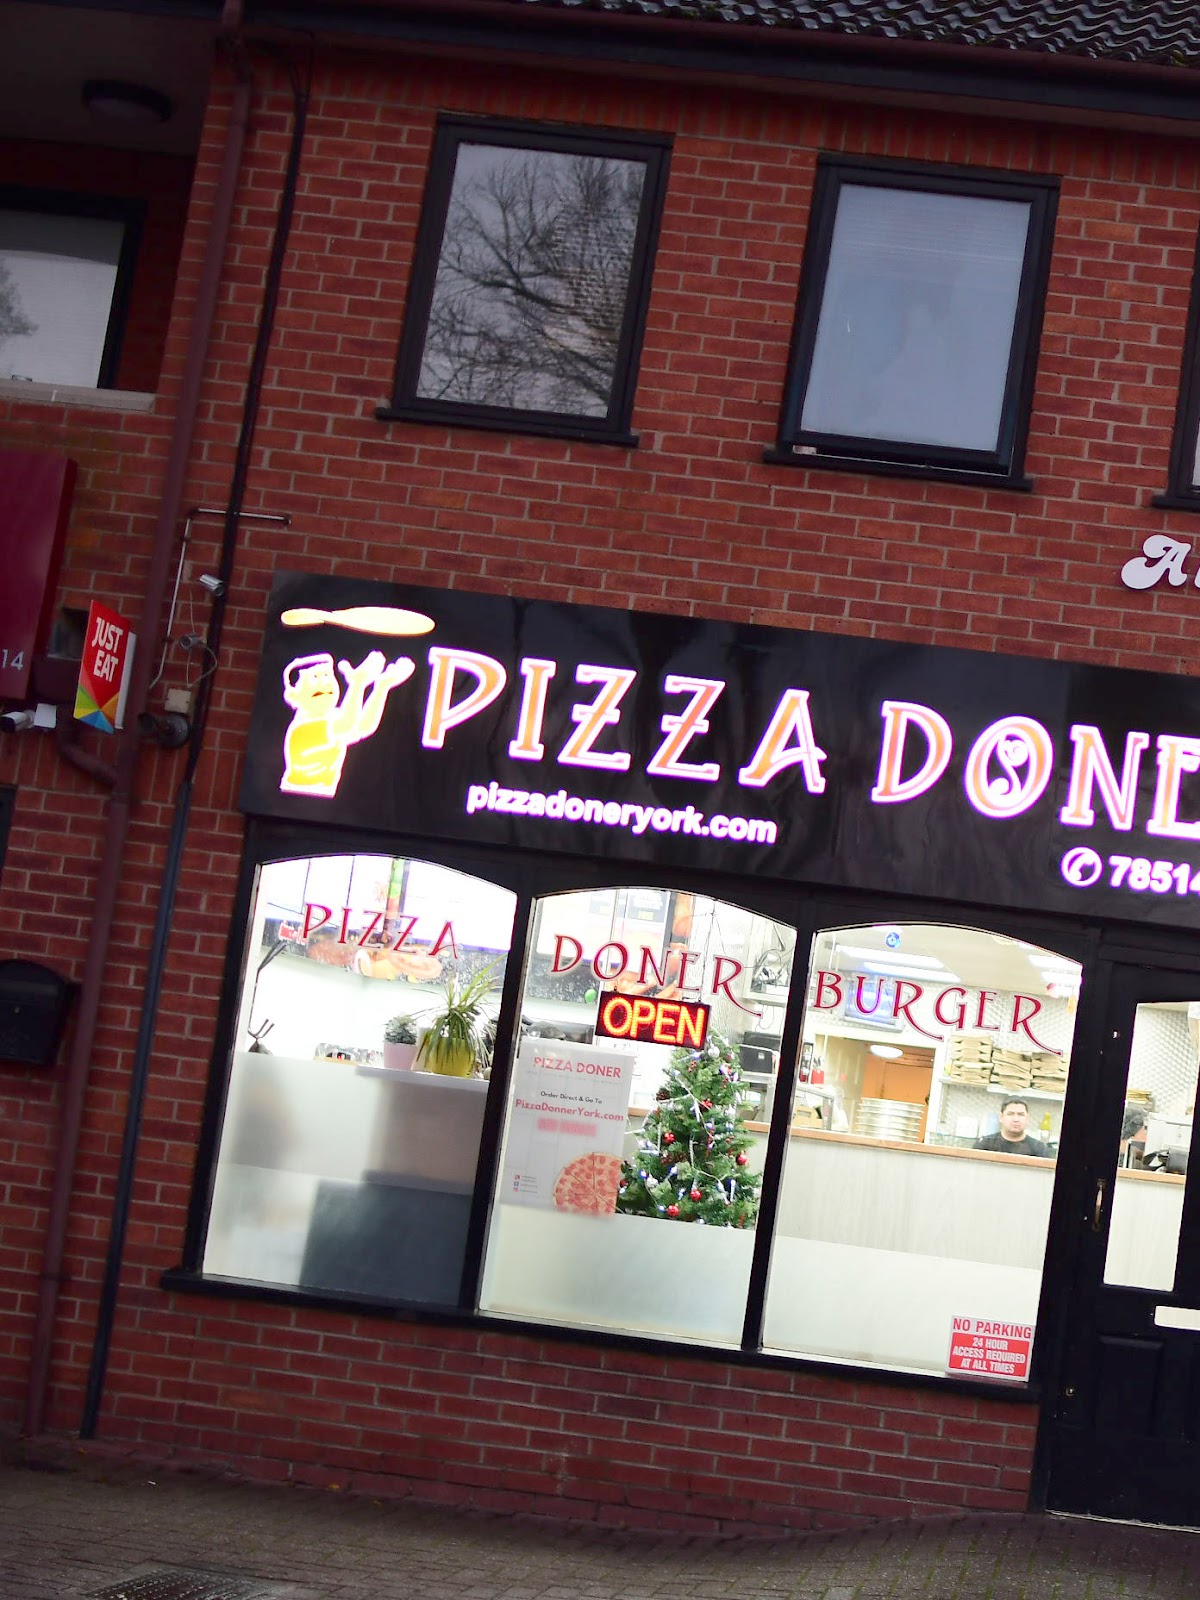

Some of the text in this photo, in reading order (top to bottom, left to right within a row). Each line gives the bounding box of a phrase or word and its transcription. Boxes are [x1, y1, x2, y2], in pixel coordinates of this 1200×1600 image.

[92, 617, 123, 653] JUST
[93, 650, 119, 682] EAT
[421, 646, 827, 793] PIZZA
[466, 781, 778, 844] pizzadoneryork.com
[302, 903, 459, 959] PIZZA
[552, 934, 762, 1017] DONER
[603, 997, 705, 1047] OPEN
[813, 971, 1062, 1055] BURGER
[533, 1057, 572, 1072] PIZZA
[576, 1062, 621, 1078] DONER
[515, 1098, 624, 1121] PizzaDonnerYork.com
[540, 1091, 558, 1099] Order
[560, 1093, 578, 1102] Direct
[953, 1318, 1032, 1338] NO PARKING
[972, 1337, 1008, 1350] 24 HOUR
[952, 1346, 1026, 1364] ACCESS REQUIRED
[961, 1358, 1015, 1374] AT ALL TIMES
